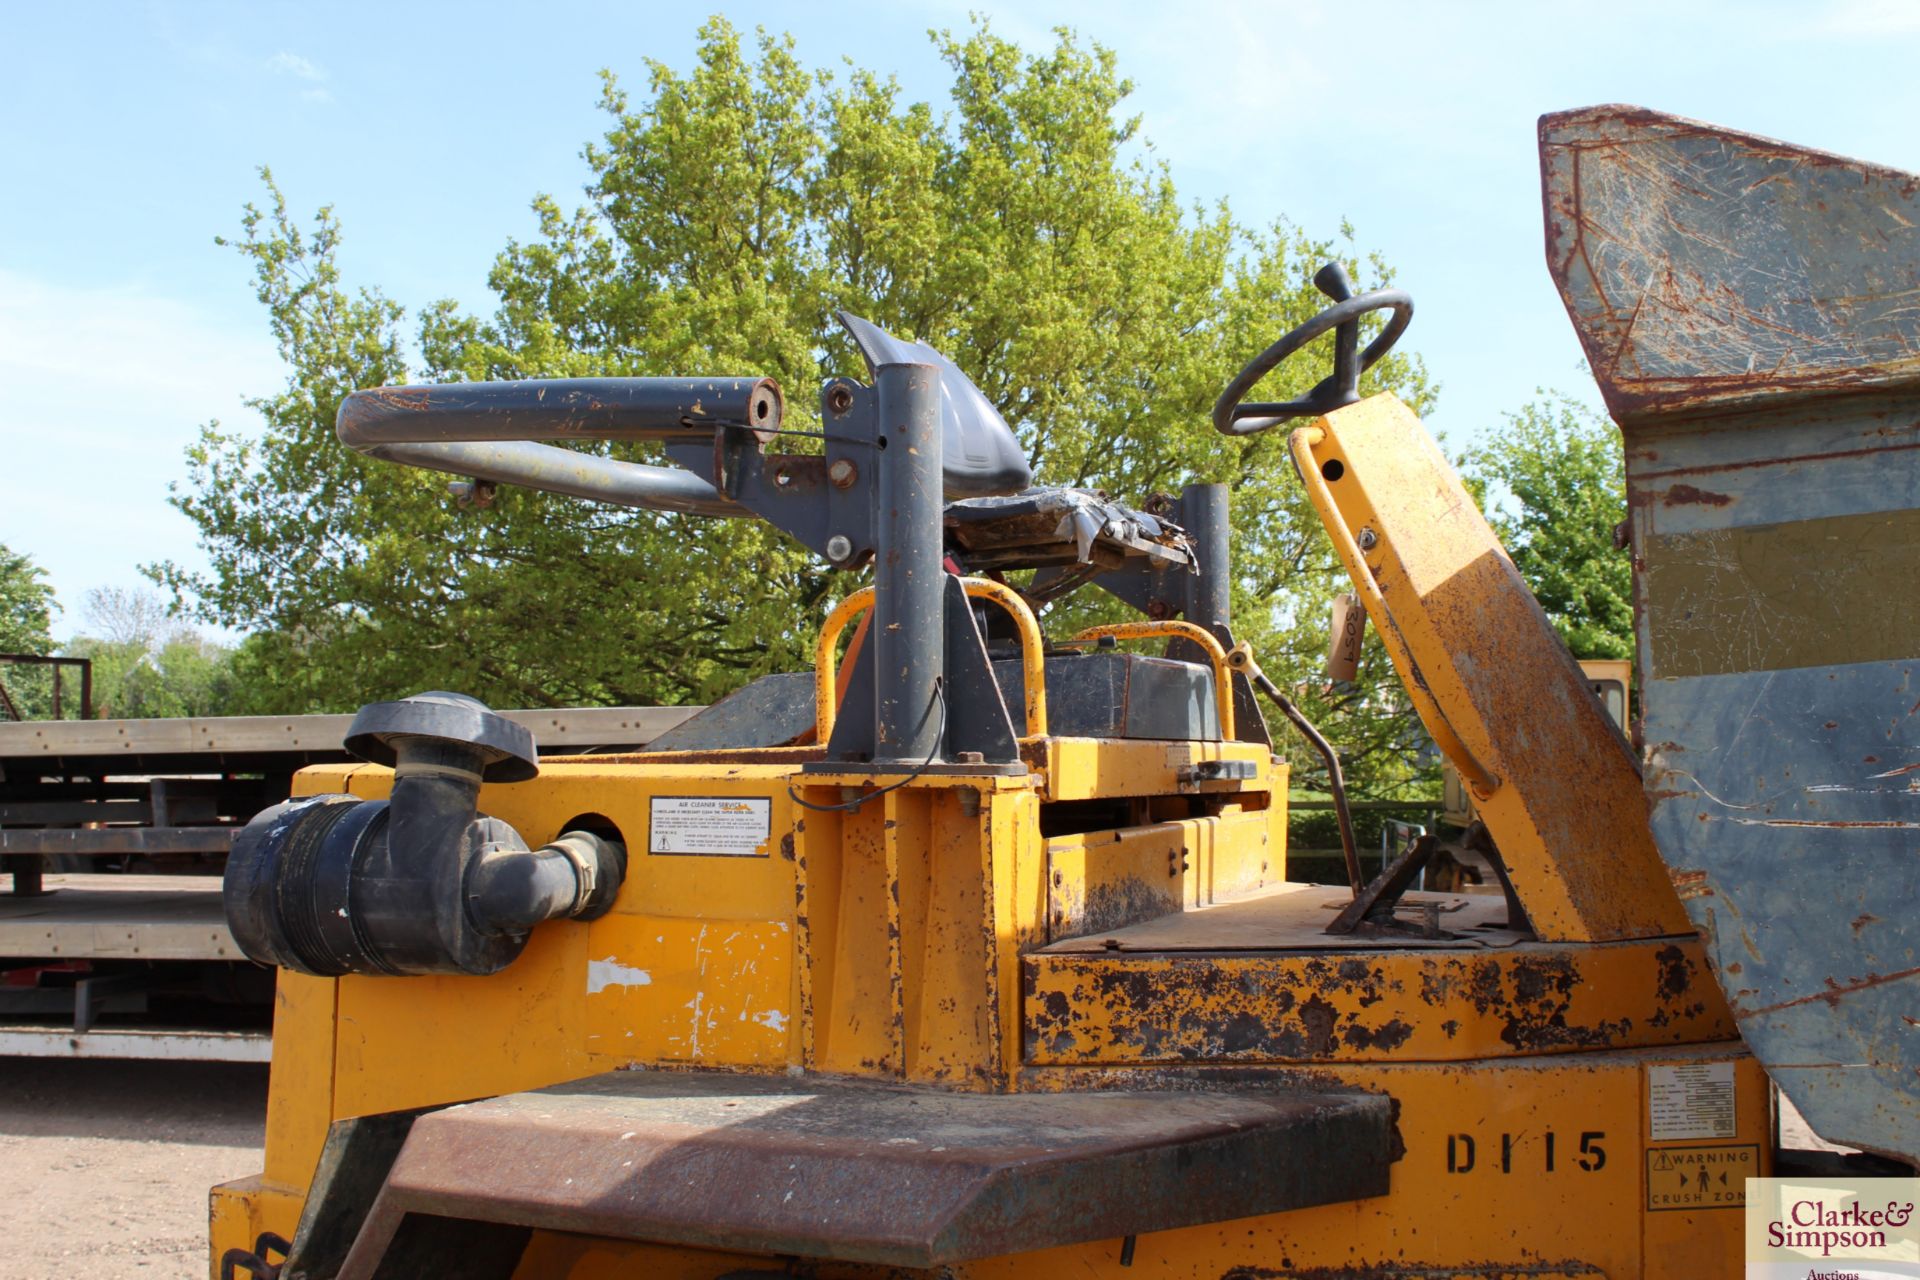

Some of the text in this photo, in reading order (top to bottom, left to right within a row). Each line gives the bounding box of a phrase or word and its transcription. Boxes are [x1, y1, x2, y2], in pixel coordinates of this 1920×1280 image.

[1673, 1152, 1749, 1164] WARNING
[1652, 1191, 1746, 1204] CRUSH ZON
